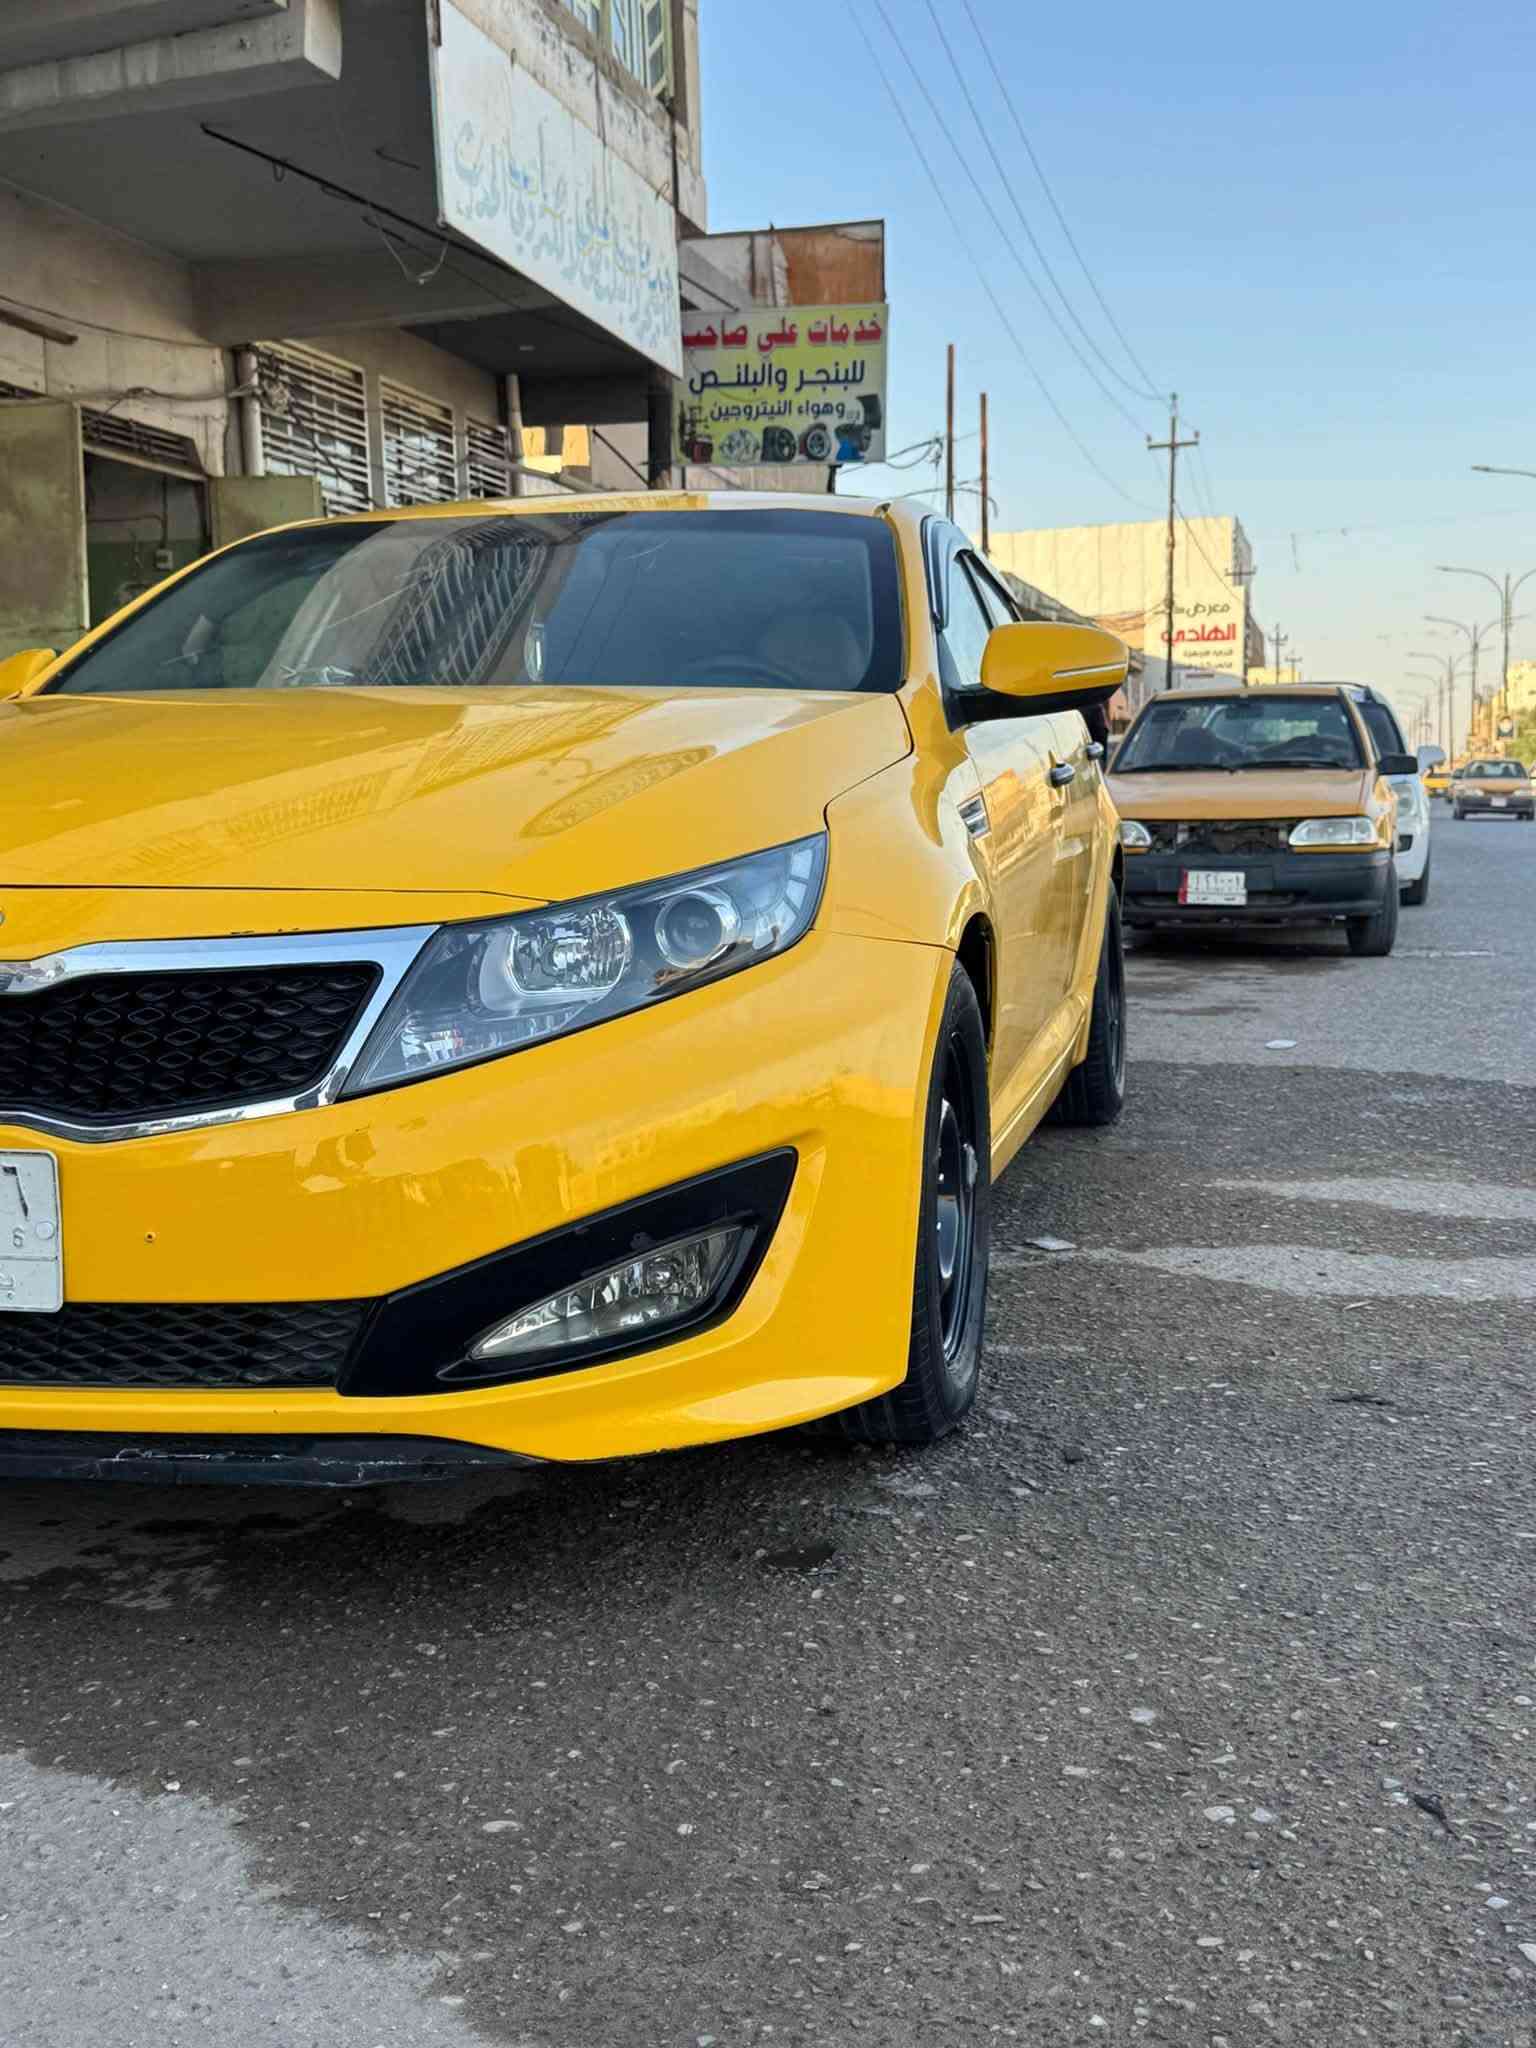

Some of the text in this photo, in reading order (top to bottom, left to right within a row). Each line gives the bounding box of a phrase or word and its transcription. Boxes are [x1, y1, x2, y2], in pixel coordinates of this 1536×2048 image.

[808, 313, 882, 345] خدمات
[689, 360, 865, 395] للبنجر والبلنص
[710, 400, 846, 422] وهواء النيتروجين
[1186, 602, 1230, 617] معرض
